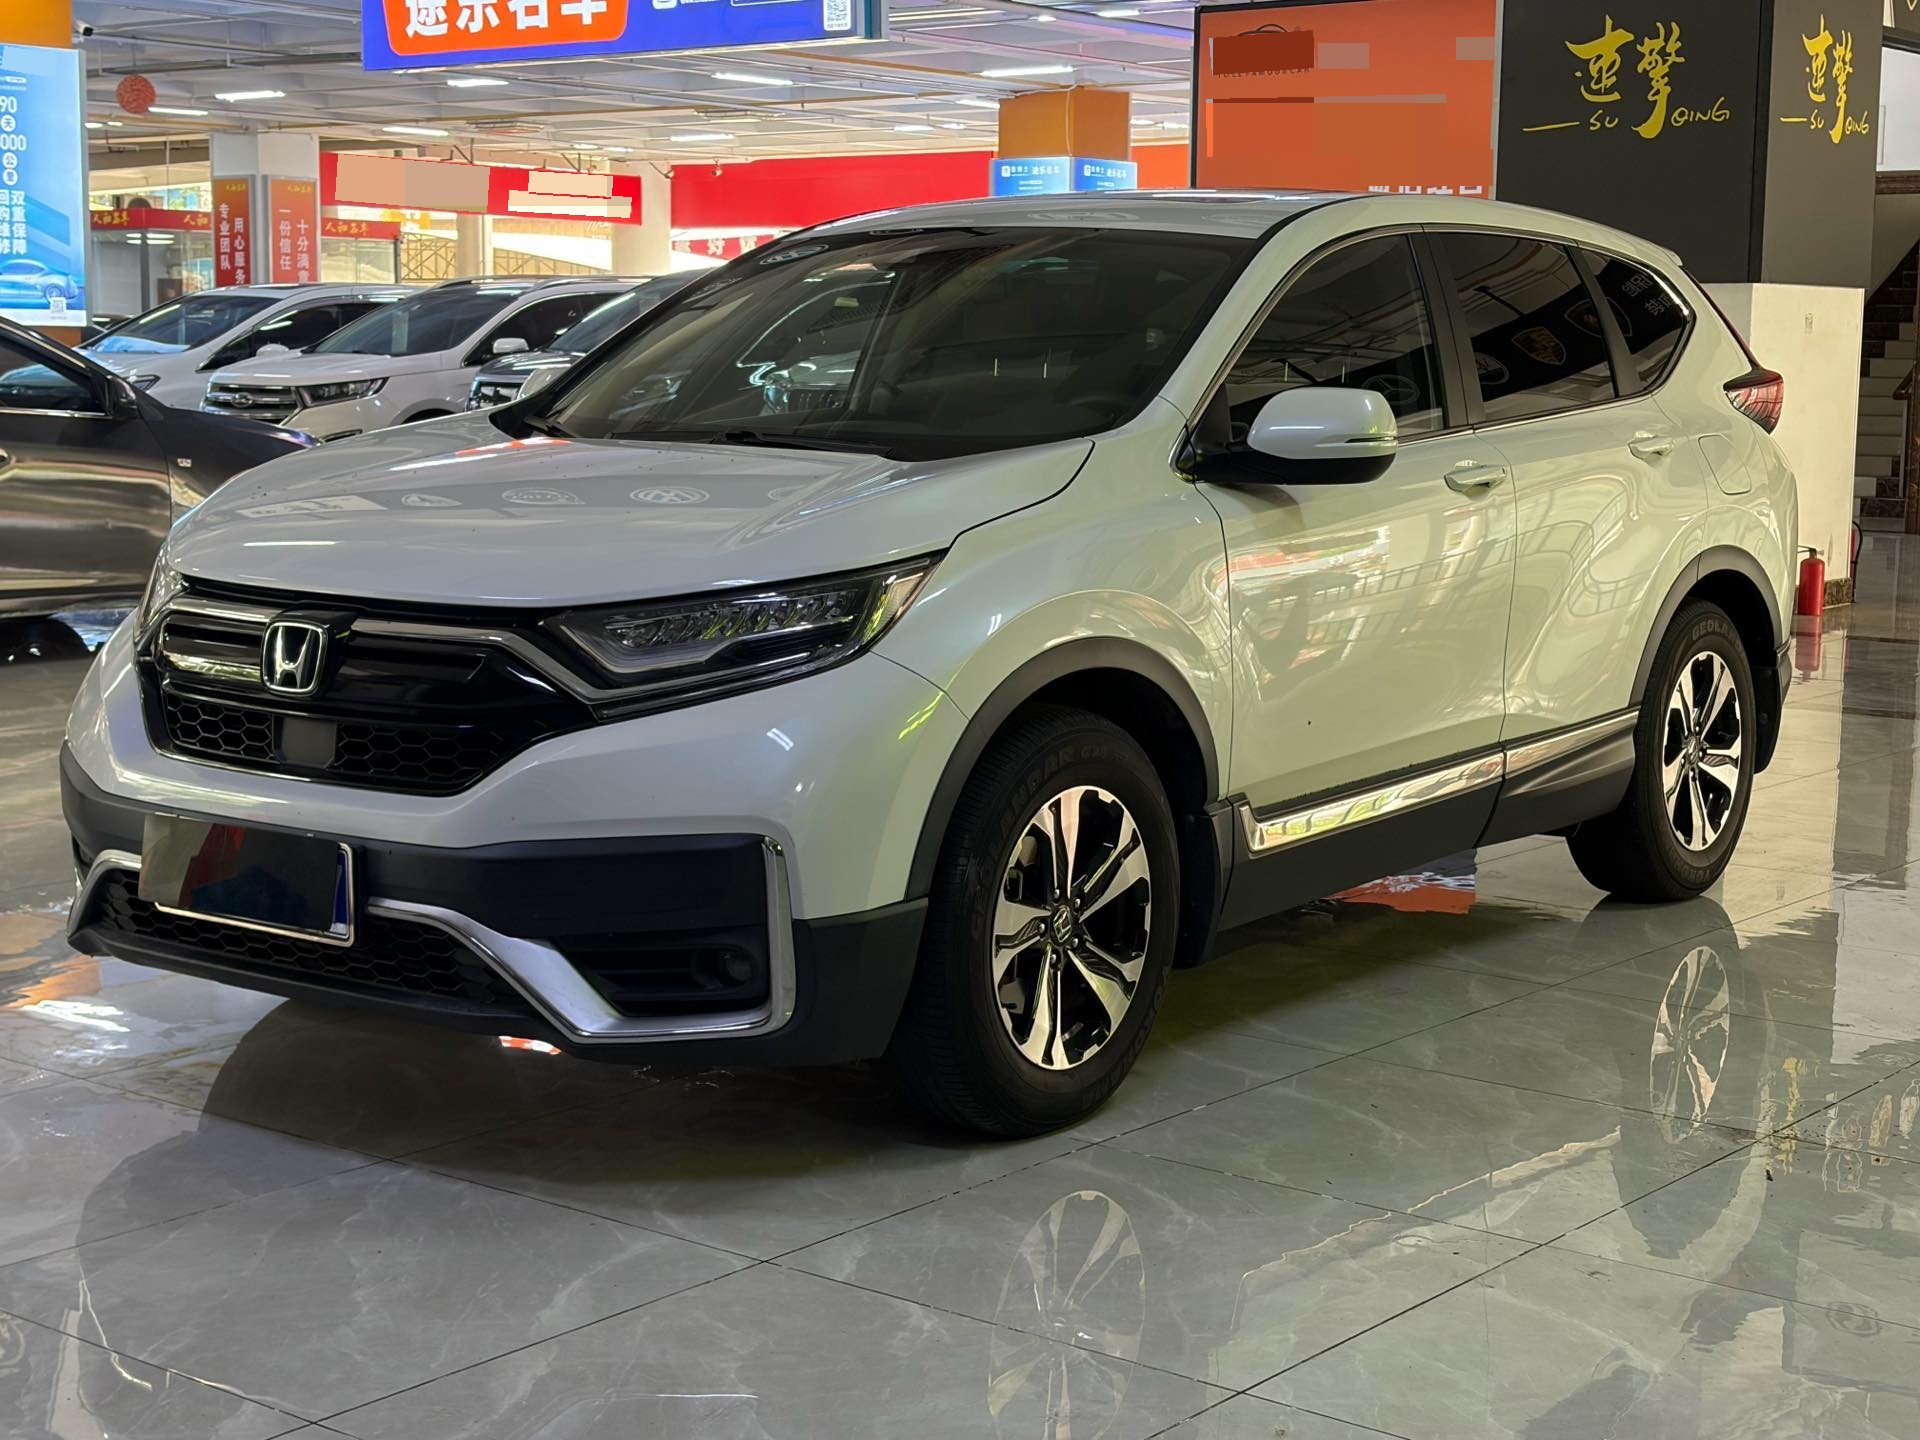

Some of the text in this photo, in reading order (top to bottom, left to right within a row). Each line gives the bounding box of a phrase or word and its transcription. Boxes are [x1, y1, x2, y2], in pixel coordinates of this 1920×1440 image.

[1588, 96, 1731, 131] SU QING
[1809, 112, 1825, 130] SU
[219, 202, 231, 271] 专业团队
[233, 217, 246, 285] 用心服务
[278, 208, 292, 271] 一份信任
